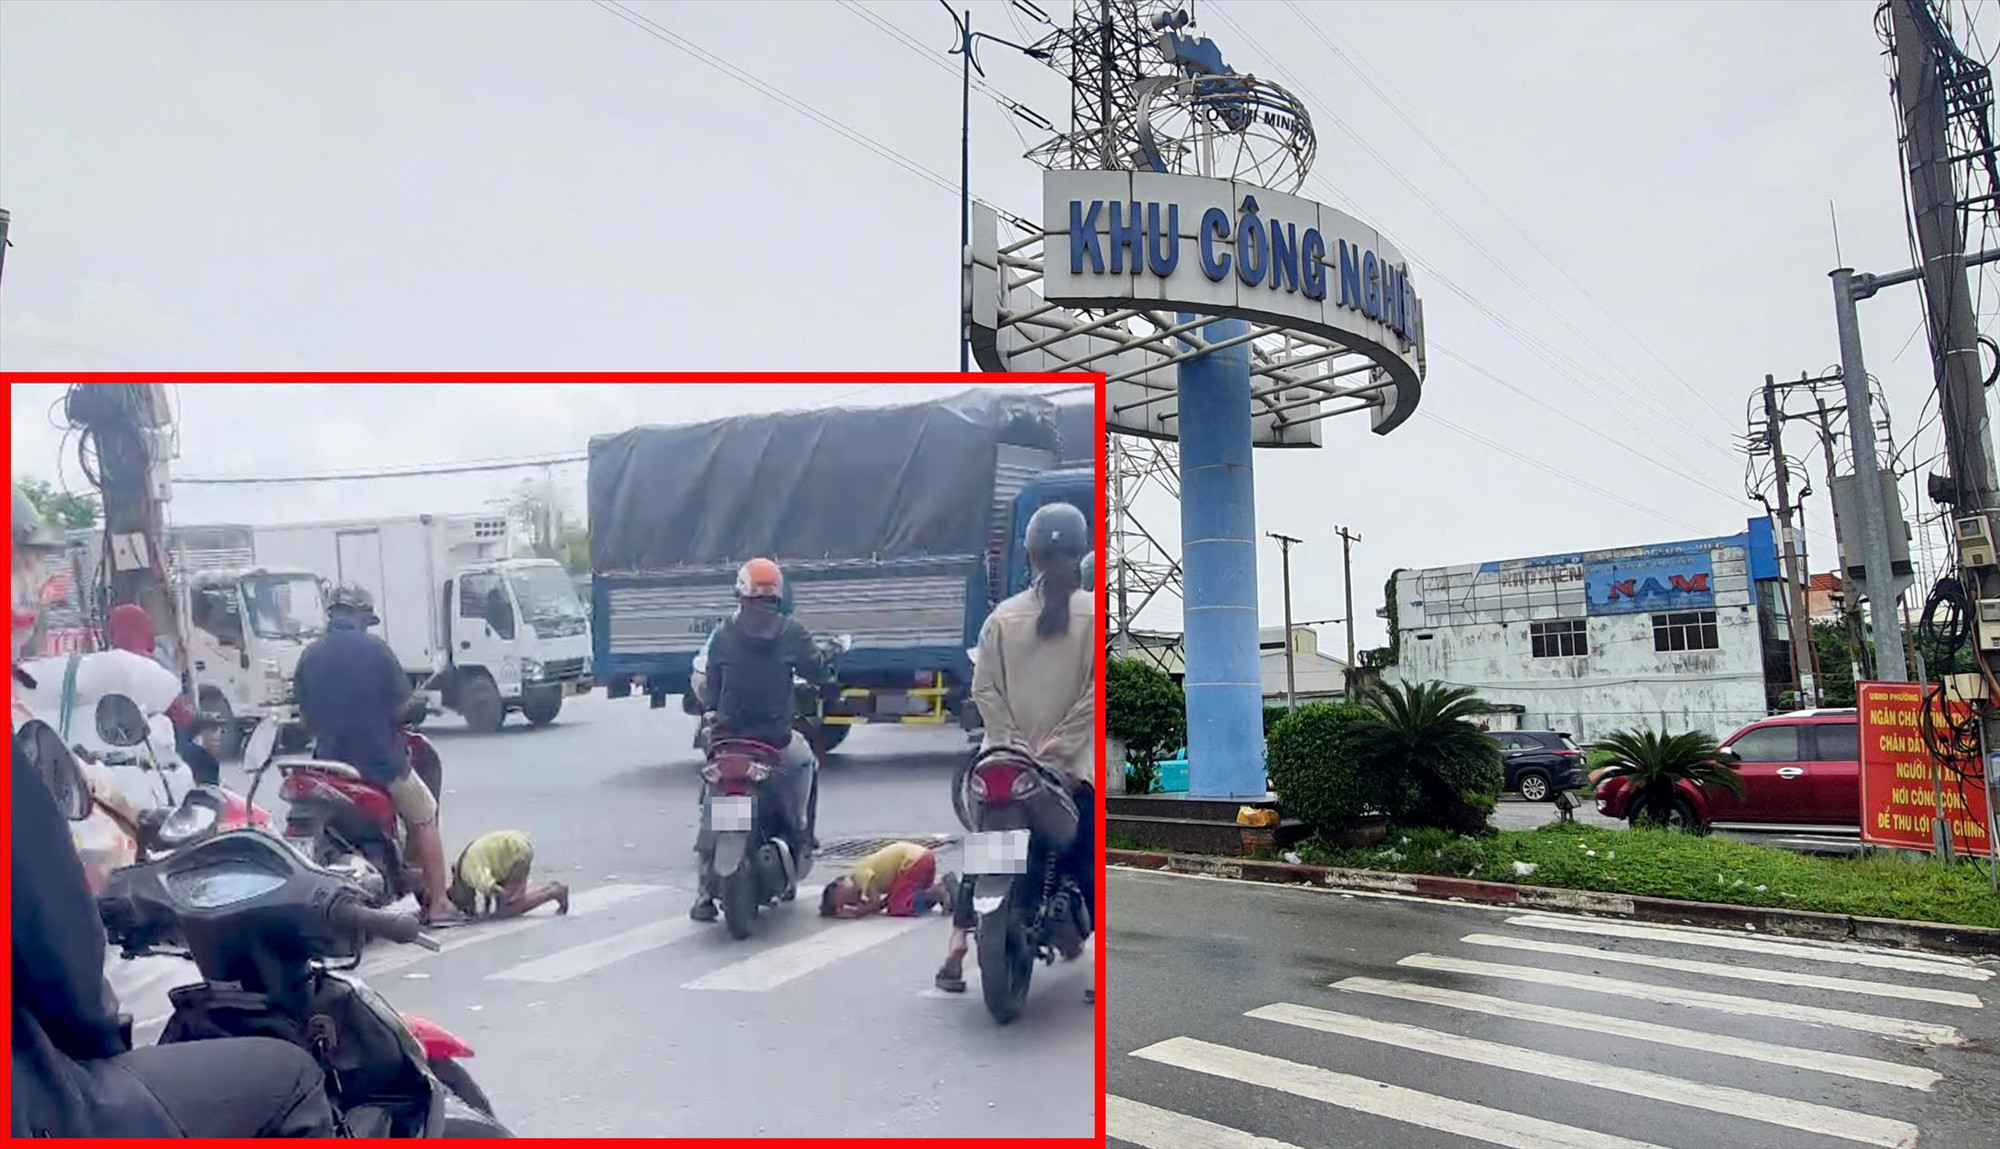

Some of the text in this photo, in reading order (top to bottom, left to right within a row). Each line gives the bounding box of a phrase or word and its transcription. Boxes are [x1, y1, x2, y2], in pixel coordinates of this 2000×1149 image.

[1069, 200, 1179, 278] KHU
[1199, 194, 1327, 300] CÔNG
[1607, 573, 1711, 601] NAM
[1869, 692, 1889, 701] UBND
[1896, 758, 1926, 779] NGƯỜI
[1892, 813, 1912, 831] THU
